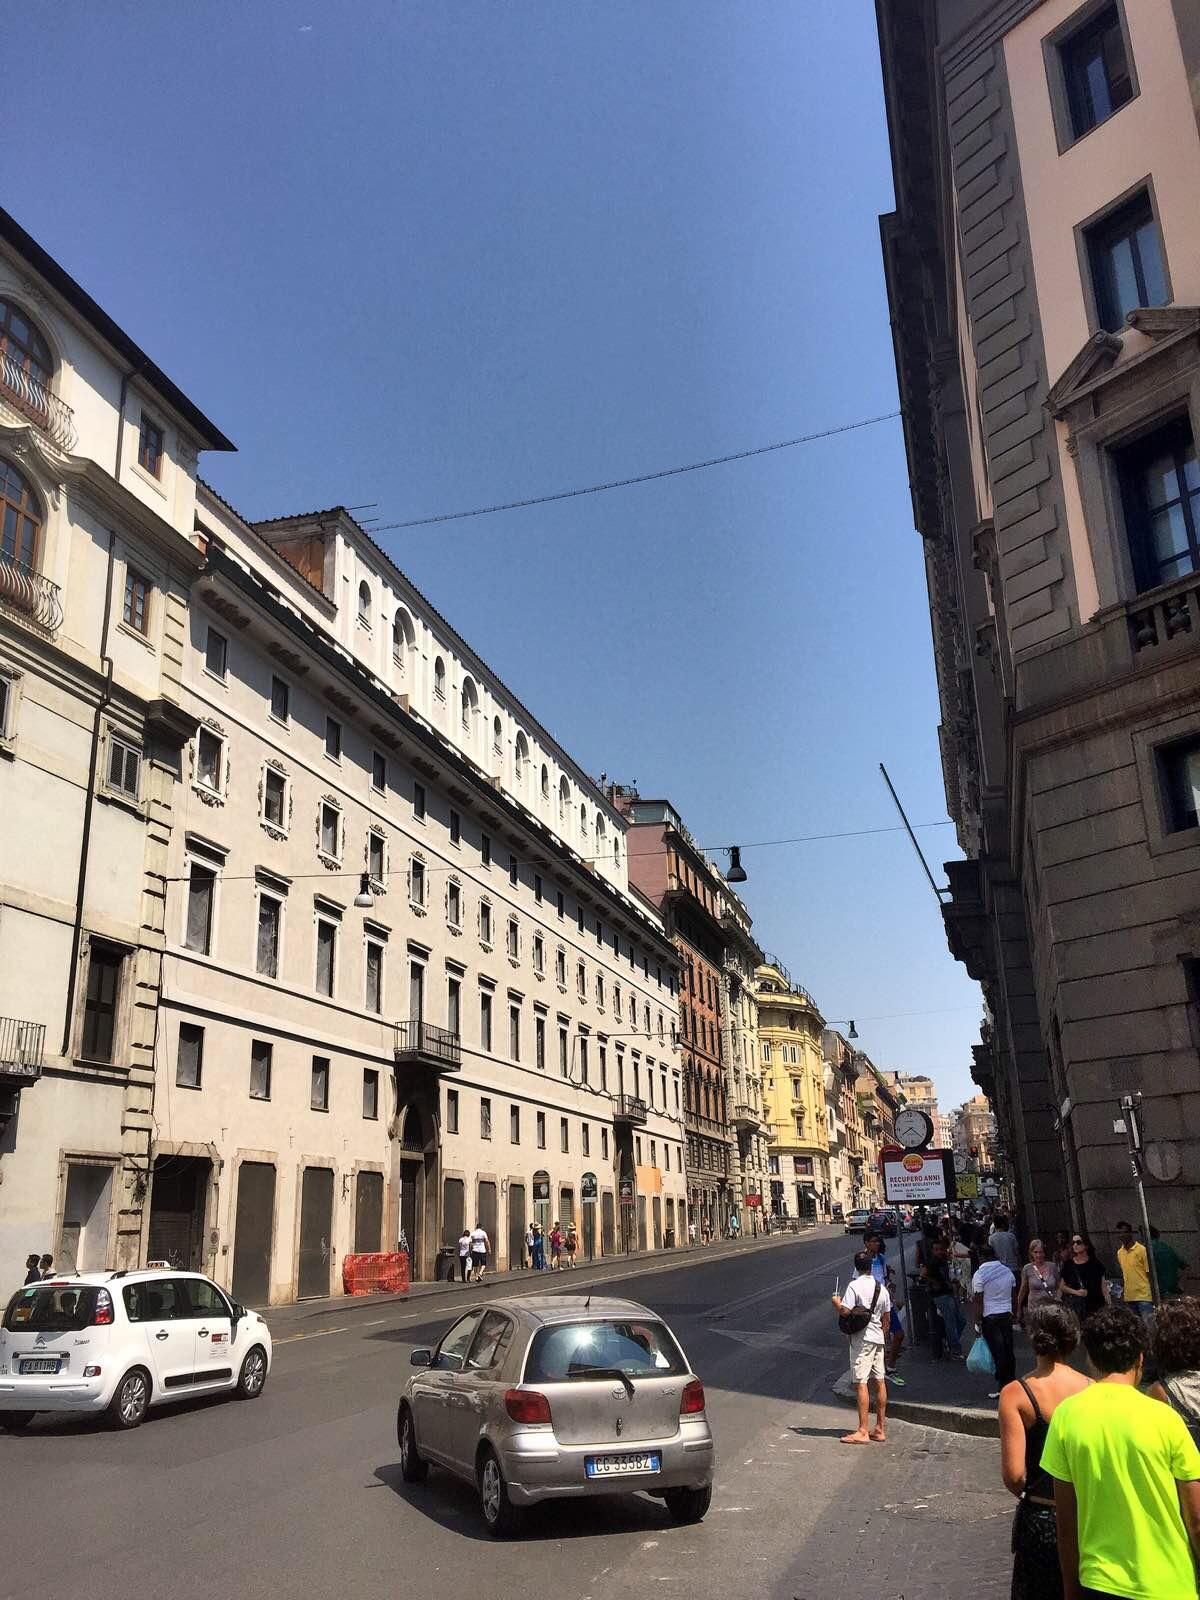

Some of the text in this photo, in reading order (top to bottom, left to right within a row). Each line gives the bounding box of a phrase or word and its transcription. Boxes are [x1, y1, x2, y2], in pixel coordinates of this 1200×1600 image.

[889, 1175, 923, 1183] RECUPERO
[596, 1455, 650, 1472] CG 335BZ
